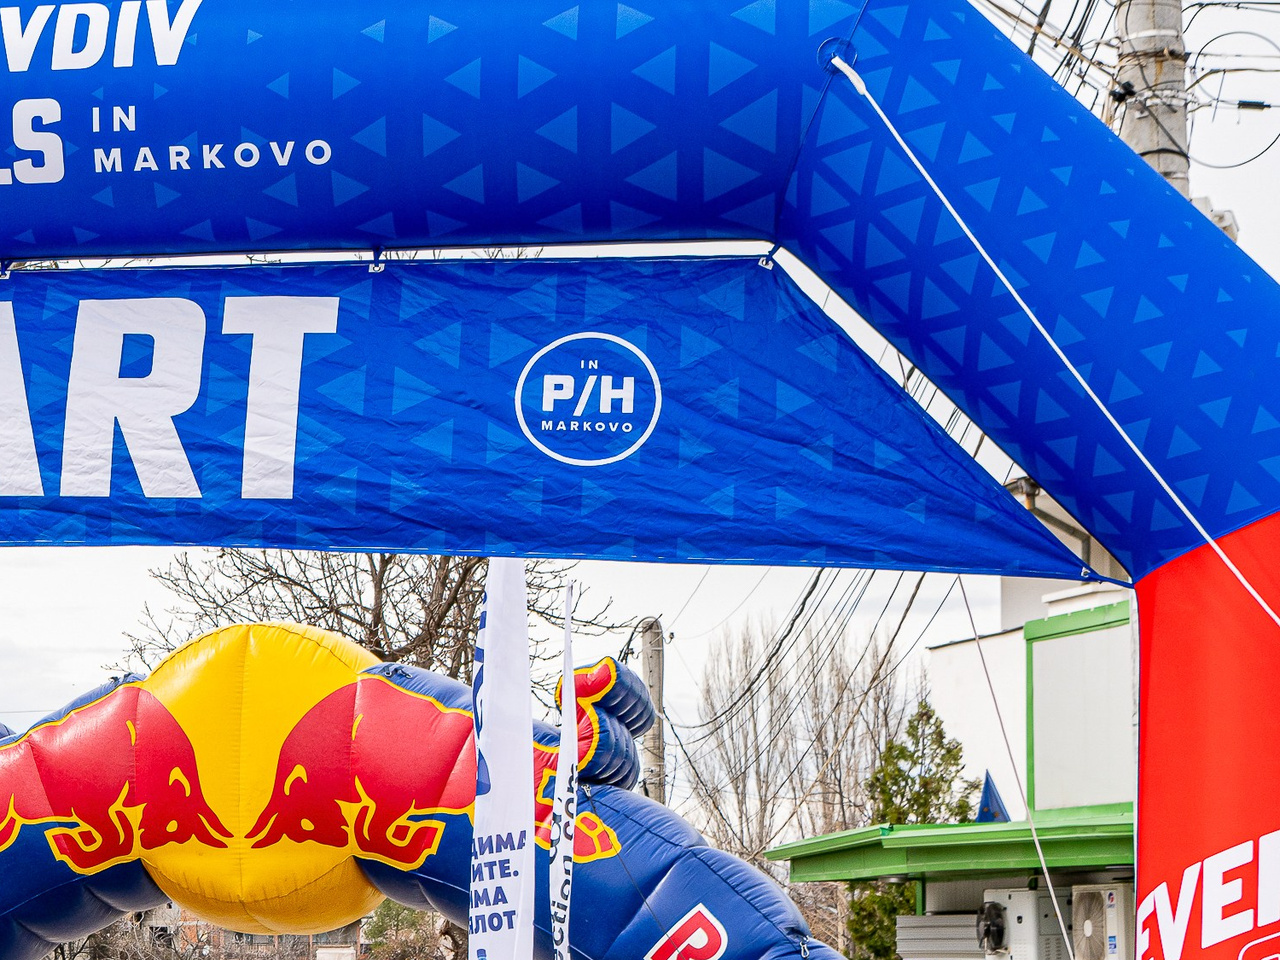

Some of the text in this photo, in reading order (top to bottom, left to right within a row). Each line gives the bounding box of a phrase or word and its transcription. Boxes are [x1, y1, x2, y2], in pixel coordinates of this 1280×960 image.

[92, 105, 136, 132] IN
[94, 139, 333, 174] MARKOVO
[580, 359, 599, 370] IN
[542, 374, 635, 417] P/H
[541, 420, 633, 433] MARKOVO
